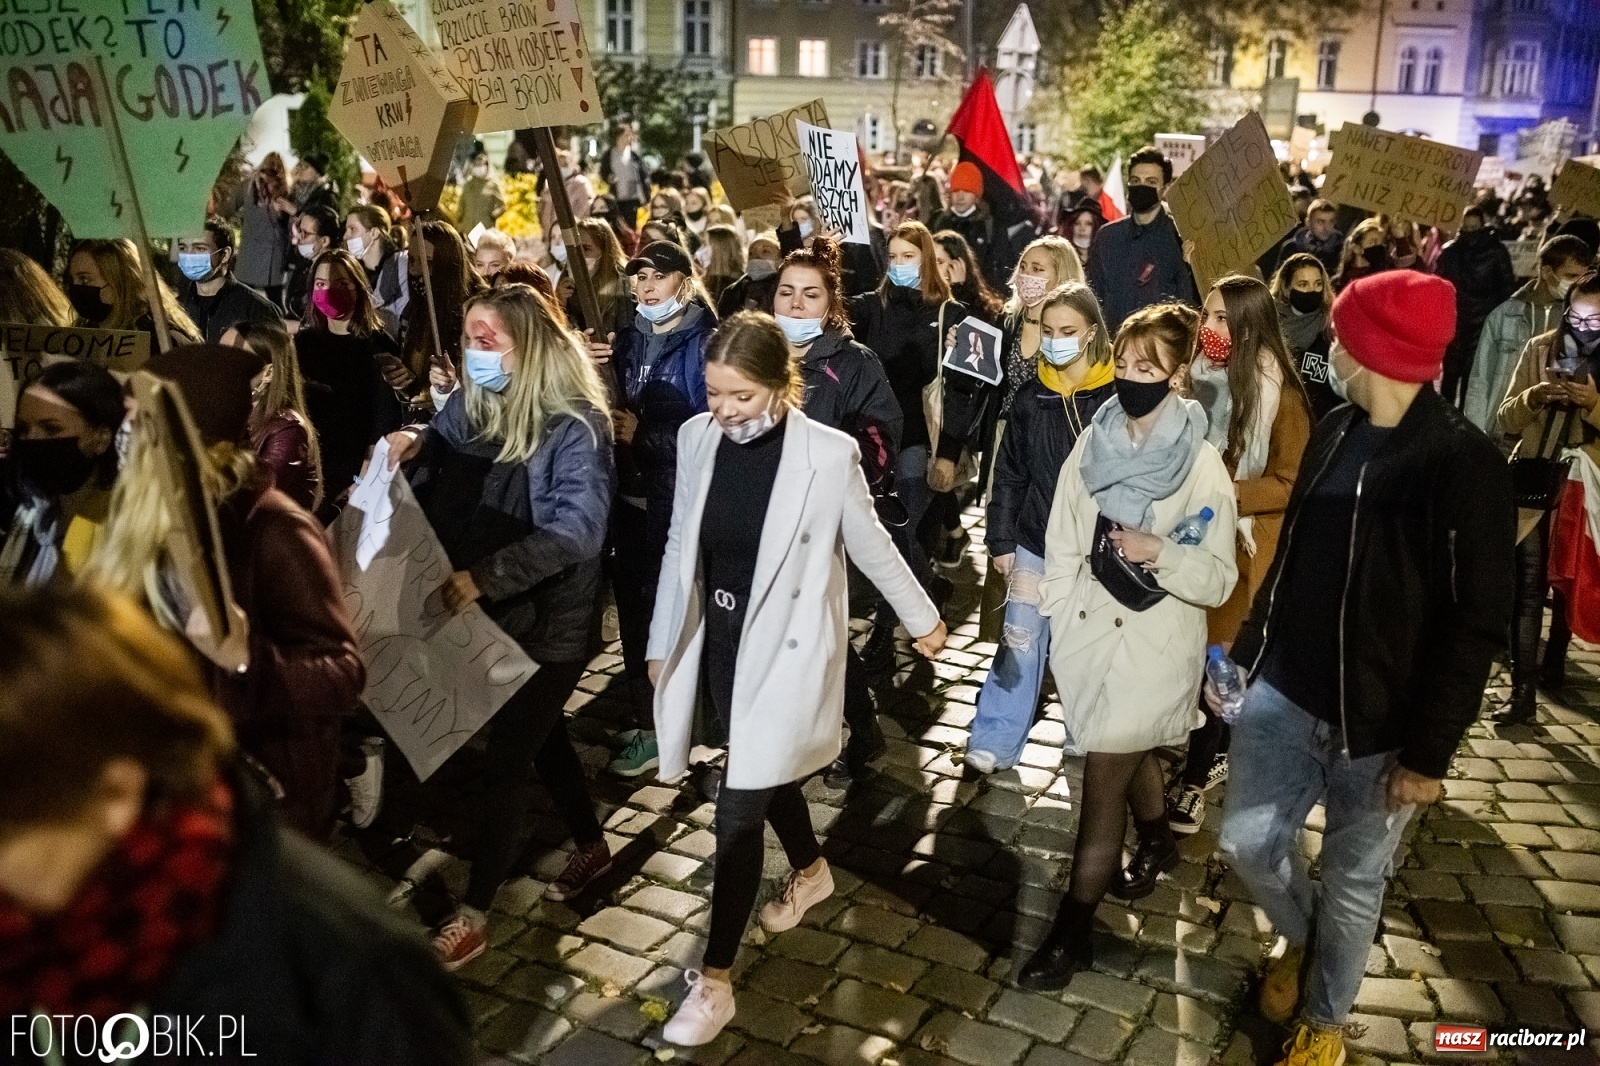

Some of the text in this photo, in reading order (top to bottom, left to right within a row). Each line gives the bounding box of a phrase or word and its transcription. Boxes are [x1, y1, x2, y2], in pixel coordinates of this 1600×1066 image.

[0, 16, 186, 59] ODEK? TO
[354, 32, 388, 67] TA
[0, 59, 262, 134] AJA GODEK
[808, 130, 835, 160] NIE
[1346, 129, 1395, 153] NAWET
[0, 325, 135, 358] ELCOME
